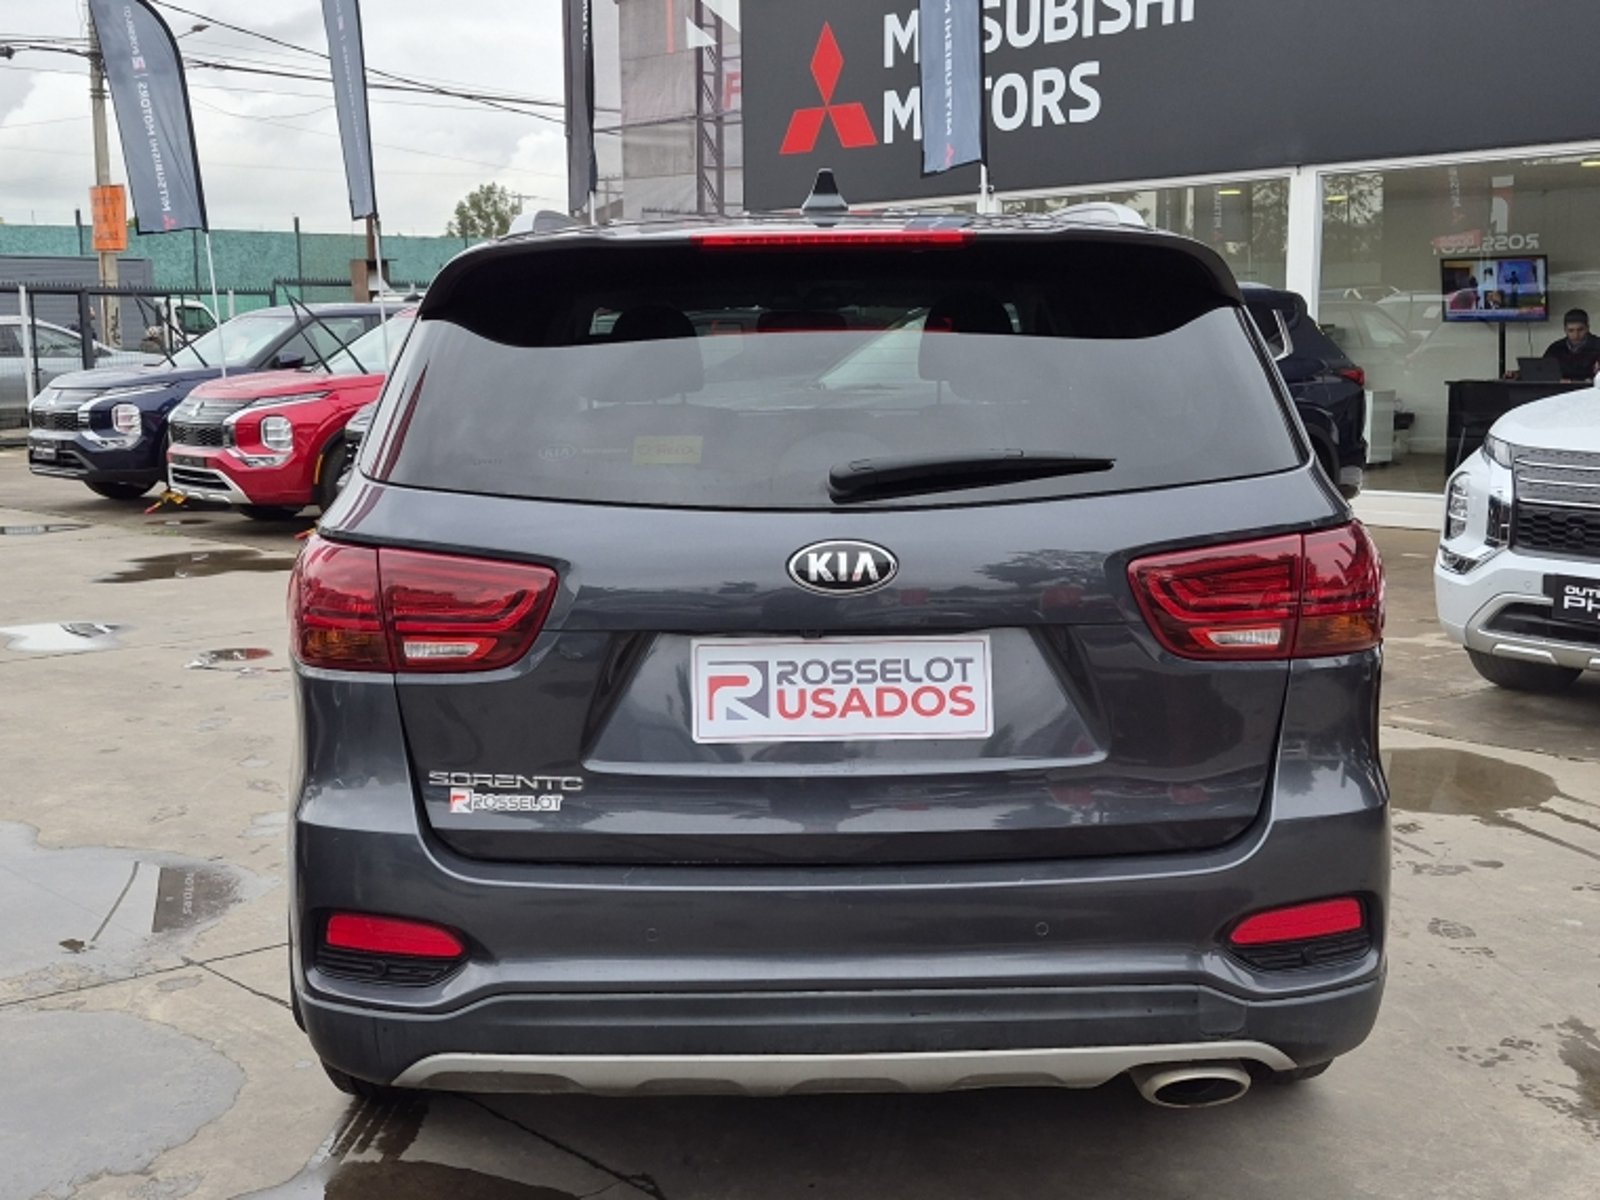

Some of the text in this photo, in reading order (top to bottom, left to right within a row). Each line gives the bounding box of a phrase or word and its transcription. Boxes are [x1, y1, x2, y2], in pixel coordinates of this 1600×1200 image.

[883, 0, 1195, 68] MSUBIS
[883, 61, 1102, 144] MORS
[807, 551, 879, 582] KIA
[1564, 585, 1600, 598] OUT
[776, 656, 974, 686] ROSSELOT
[776, 685, 976, 720] USADOS
[474, 794, 563, 811] ROSSELOT
